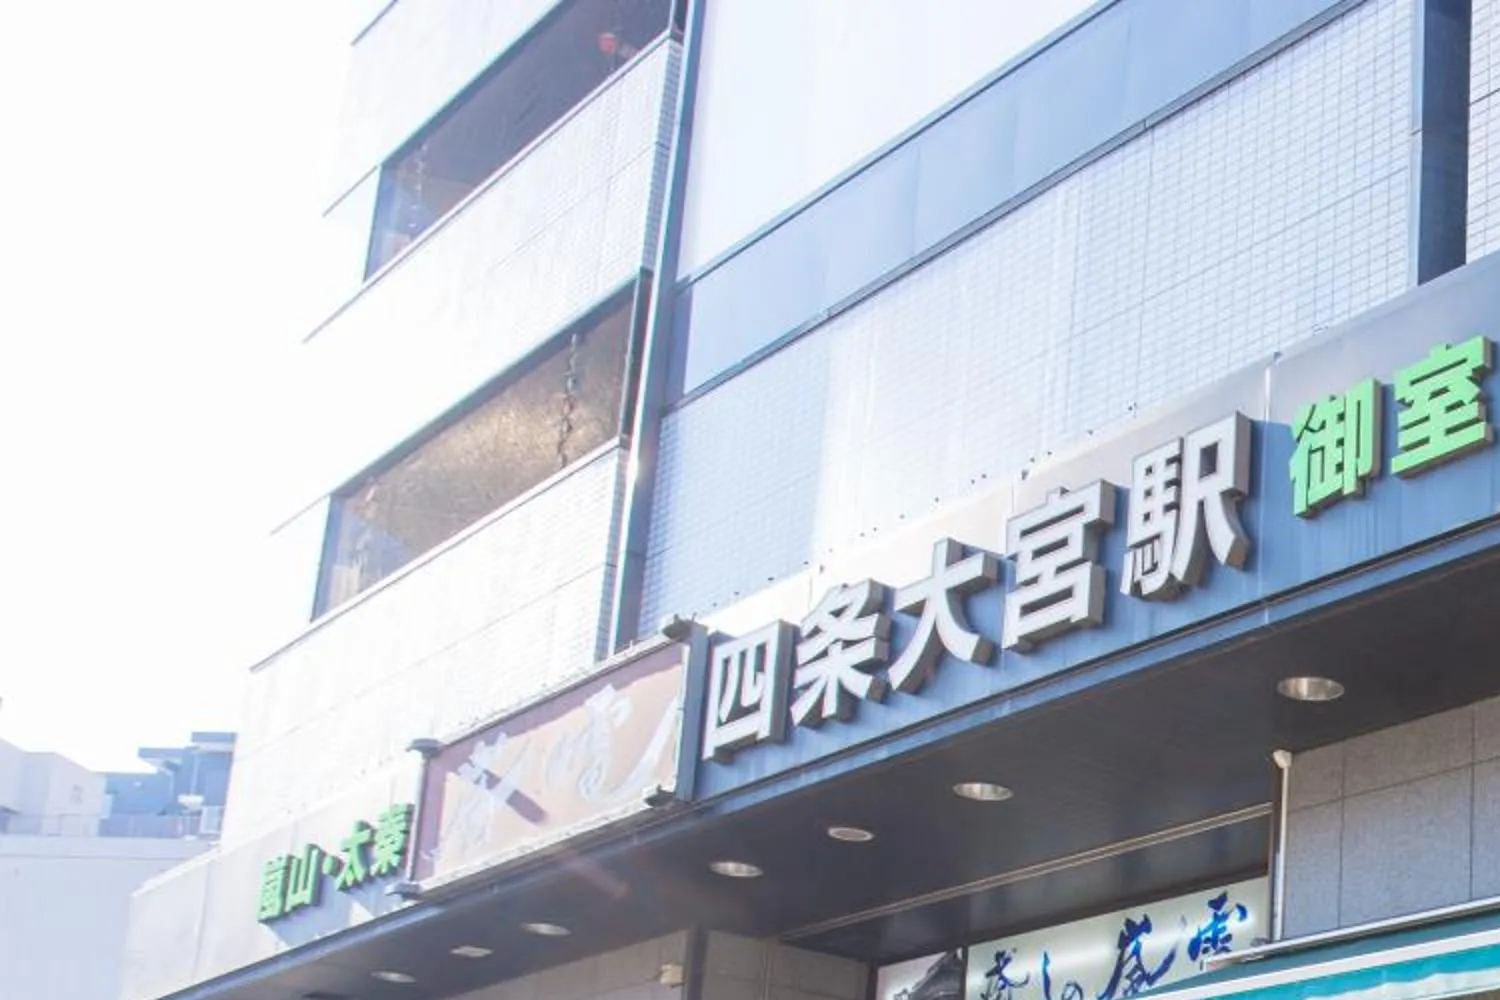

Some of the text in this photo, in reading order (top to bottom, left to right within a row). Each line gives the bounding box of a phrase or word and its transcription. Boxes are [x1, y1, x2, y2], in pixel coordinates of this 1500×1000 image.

[702, 411, 1258, 762] 四条大宮駅
